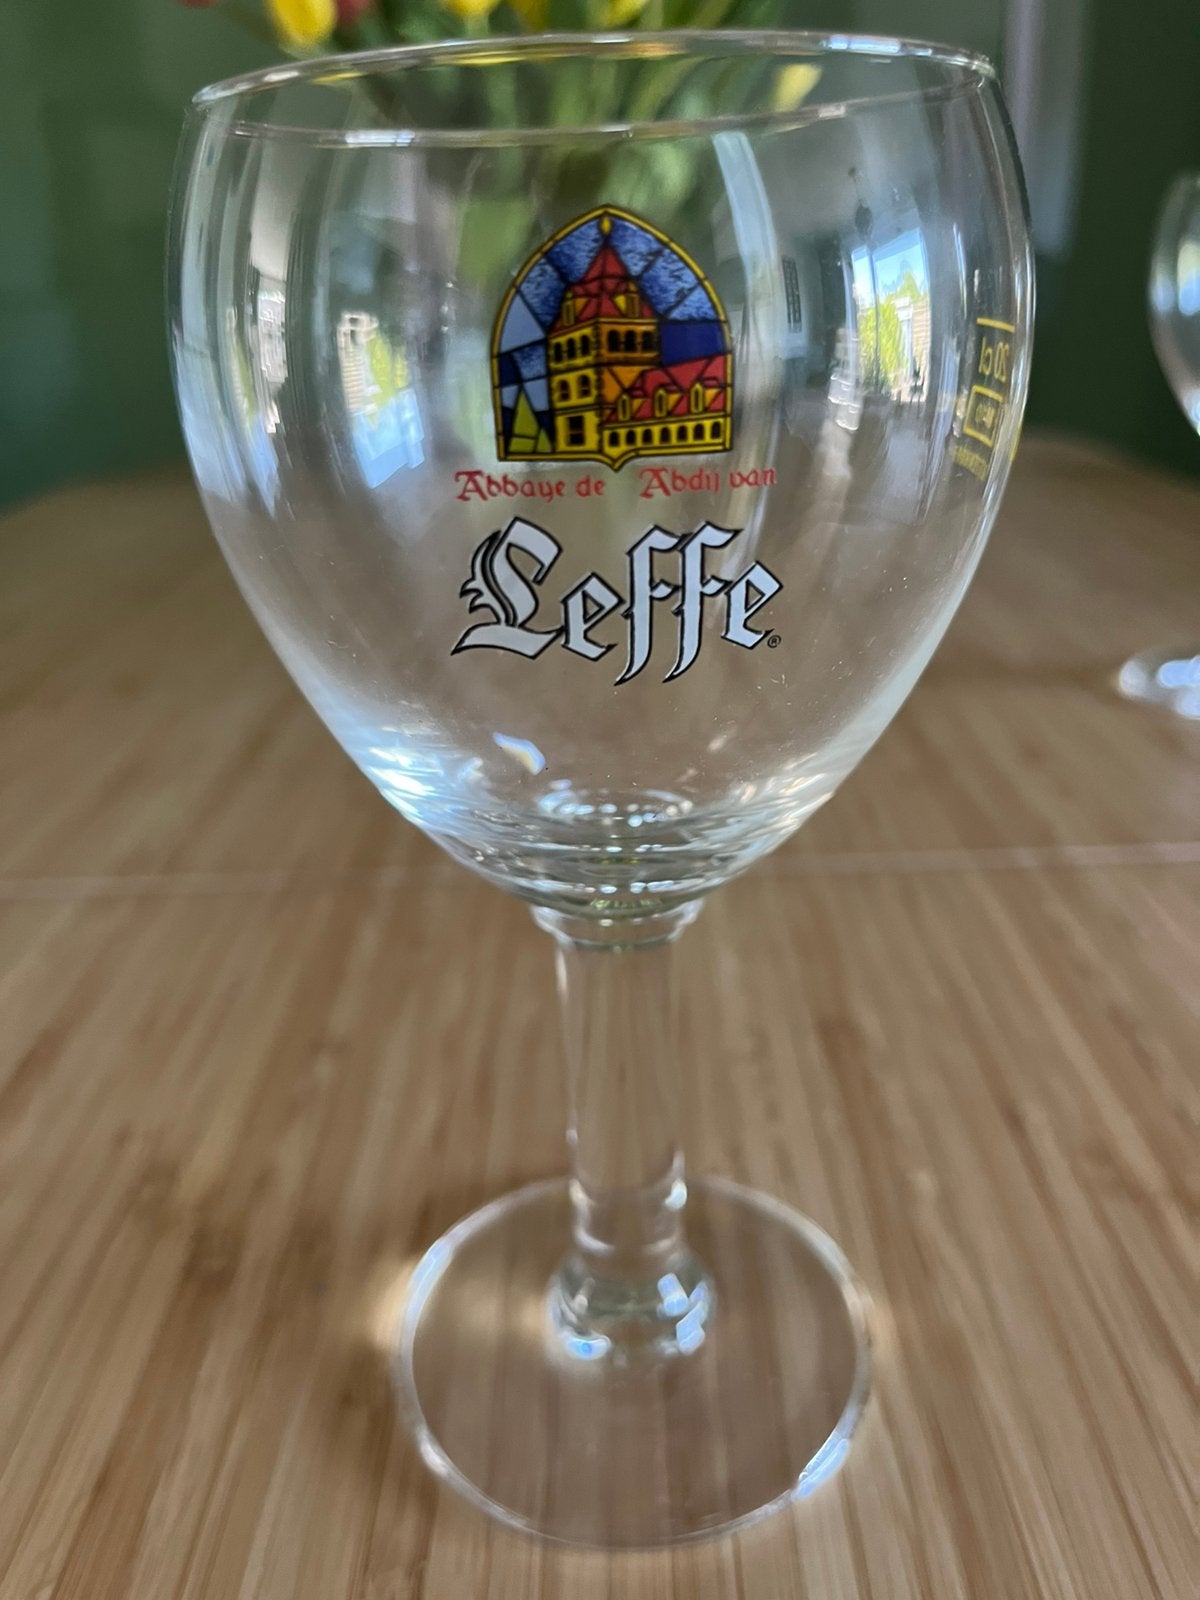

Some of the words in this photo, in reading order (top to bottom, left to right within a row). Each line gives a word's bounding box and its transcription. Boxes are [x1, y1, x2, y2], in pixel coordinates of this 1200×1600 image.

[454, 469, 564, 503] Abbaye
[576, 475, 605, 497] de
[639, 467, 720, 500] Abdij
[728, 467, 777, 489] van
[451, 516, 783, 687] Leffe
